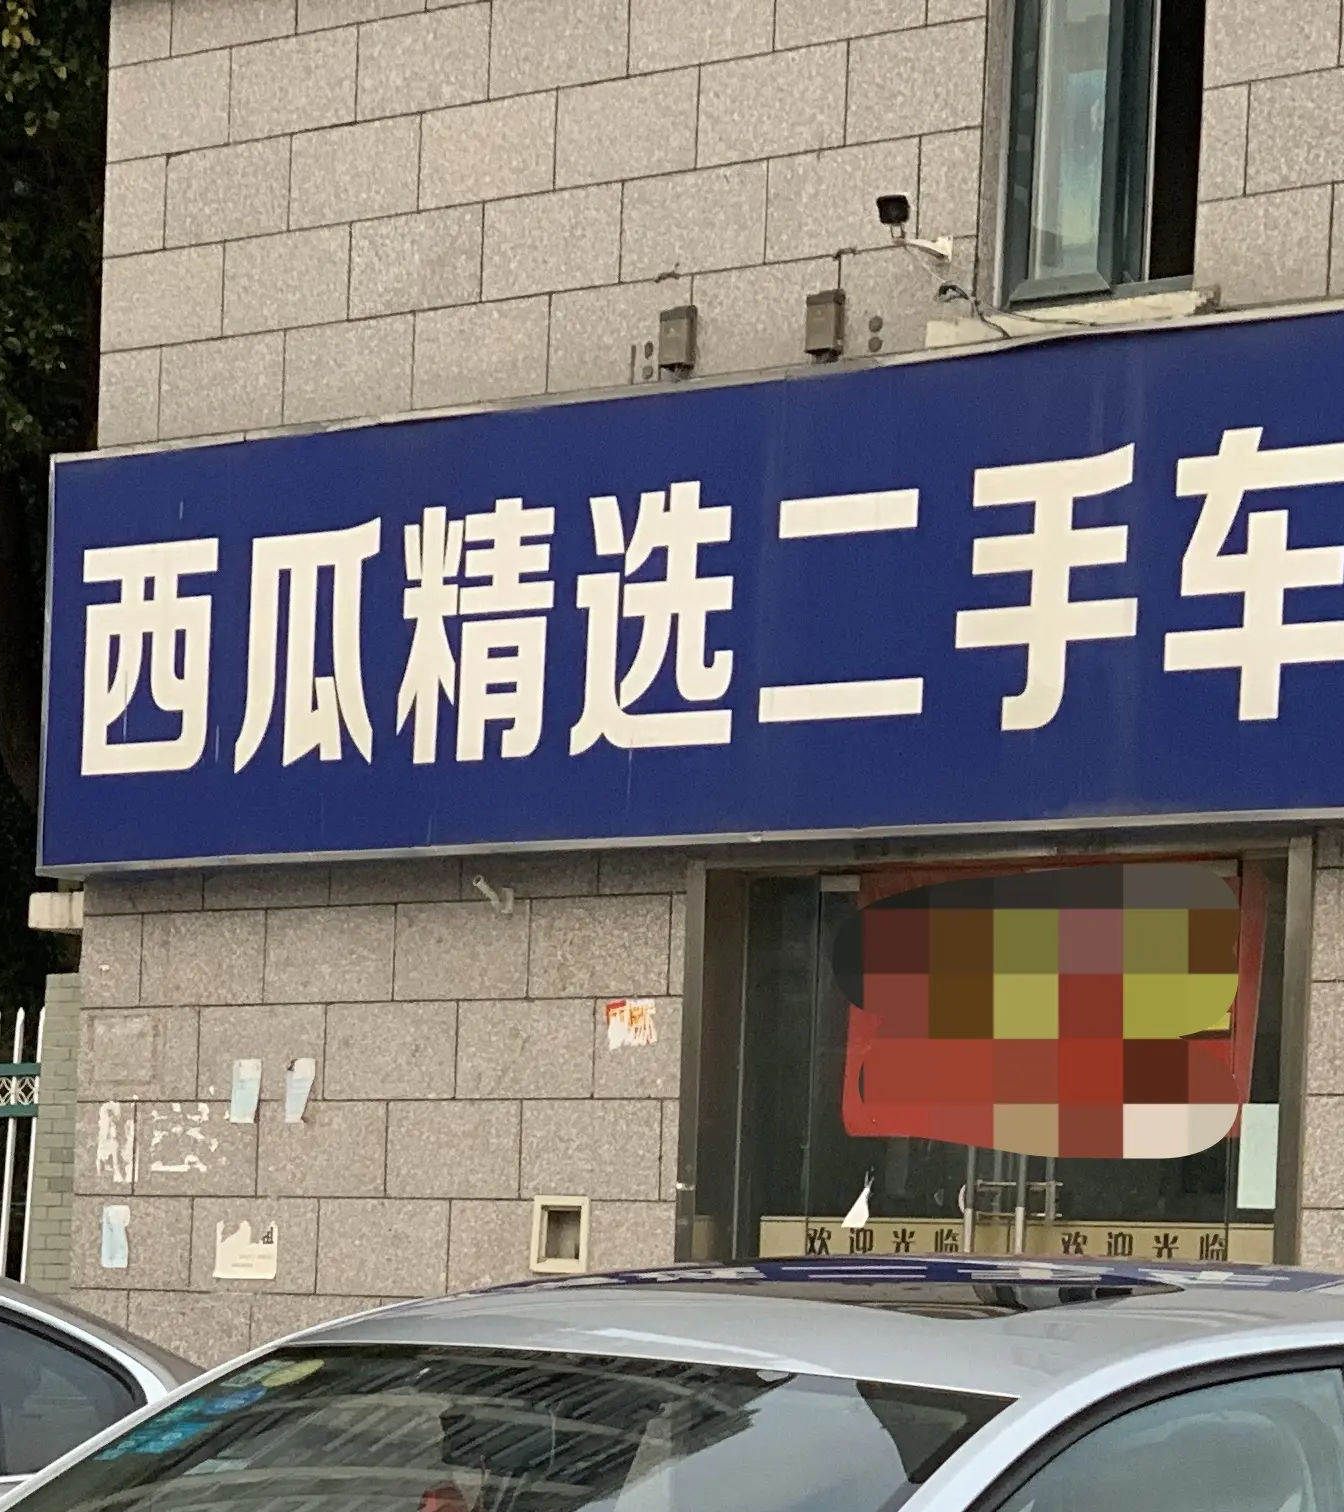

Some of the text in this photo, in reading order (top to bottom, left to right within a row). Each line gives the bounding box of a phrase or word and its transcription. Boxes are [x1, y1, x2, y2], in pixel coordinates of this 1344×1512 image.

[807, 1227, 960, 1256] 欢迎光临
[1061, 1231, 1228, 1261] 欢迎光临
